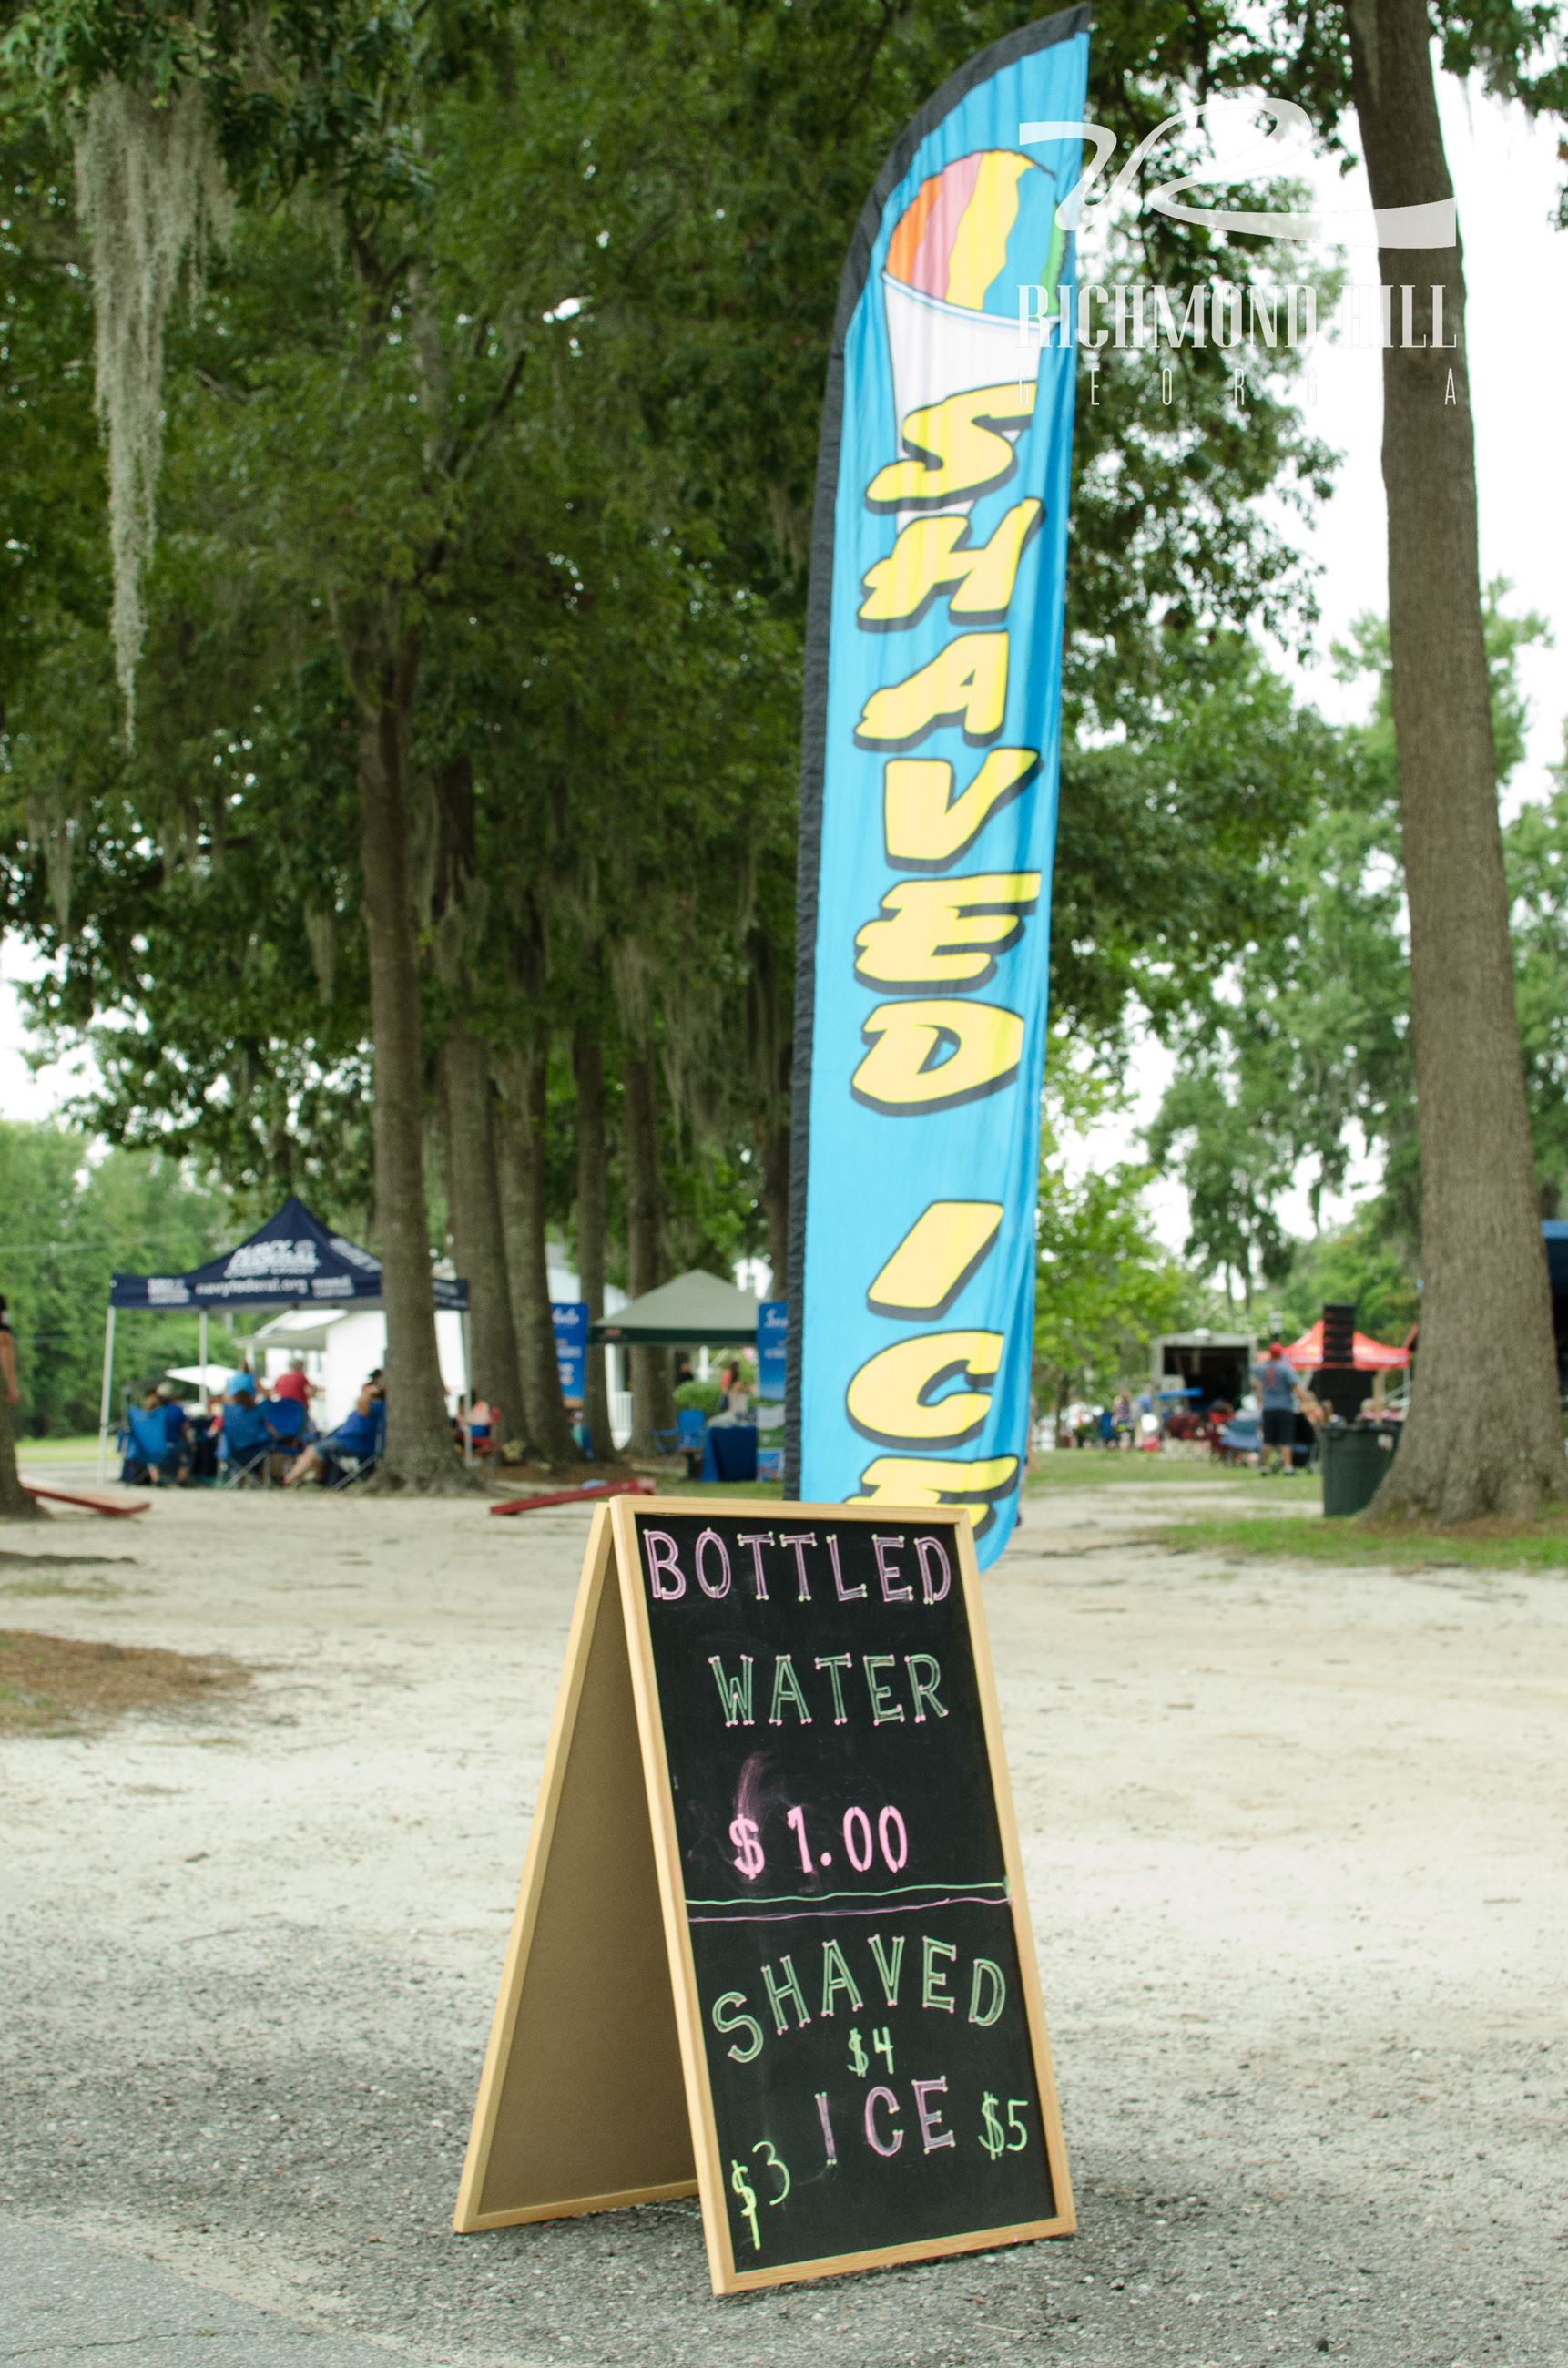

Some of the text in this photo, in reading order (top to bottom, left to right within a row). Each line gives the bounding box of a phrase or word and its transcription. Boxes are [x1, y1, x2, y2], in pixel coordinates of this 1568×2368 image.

[851, 379, 1044, 1118] SHAVED
[643, 1527, 952, 1606] BOTTLED
[708, 1652, 949, 1728] WATER
[711, 1934, 1006, 2063] SHAVED
[846, 2027, 895, 2077] $4
[814, 2075, 957, 2166] ICE
[977, 2091, 1030, 2161] $5
[730, 2140, 791, 2251] $3
